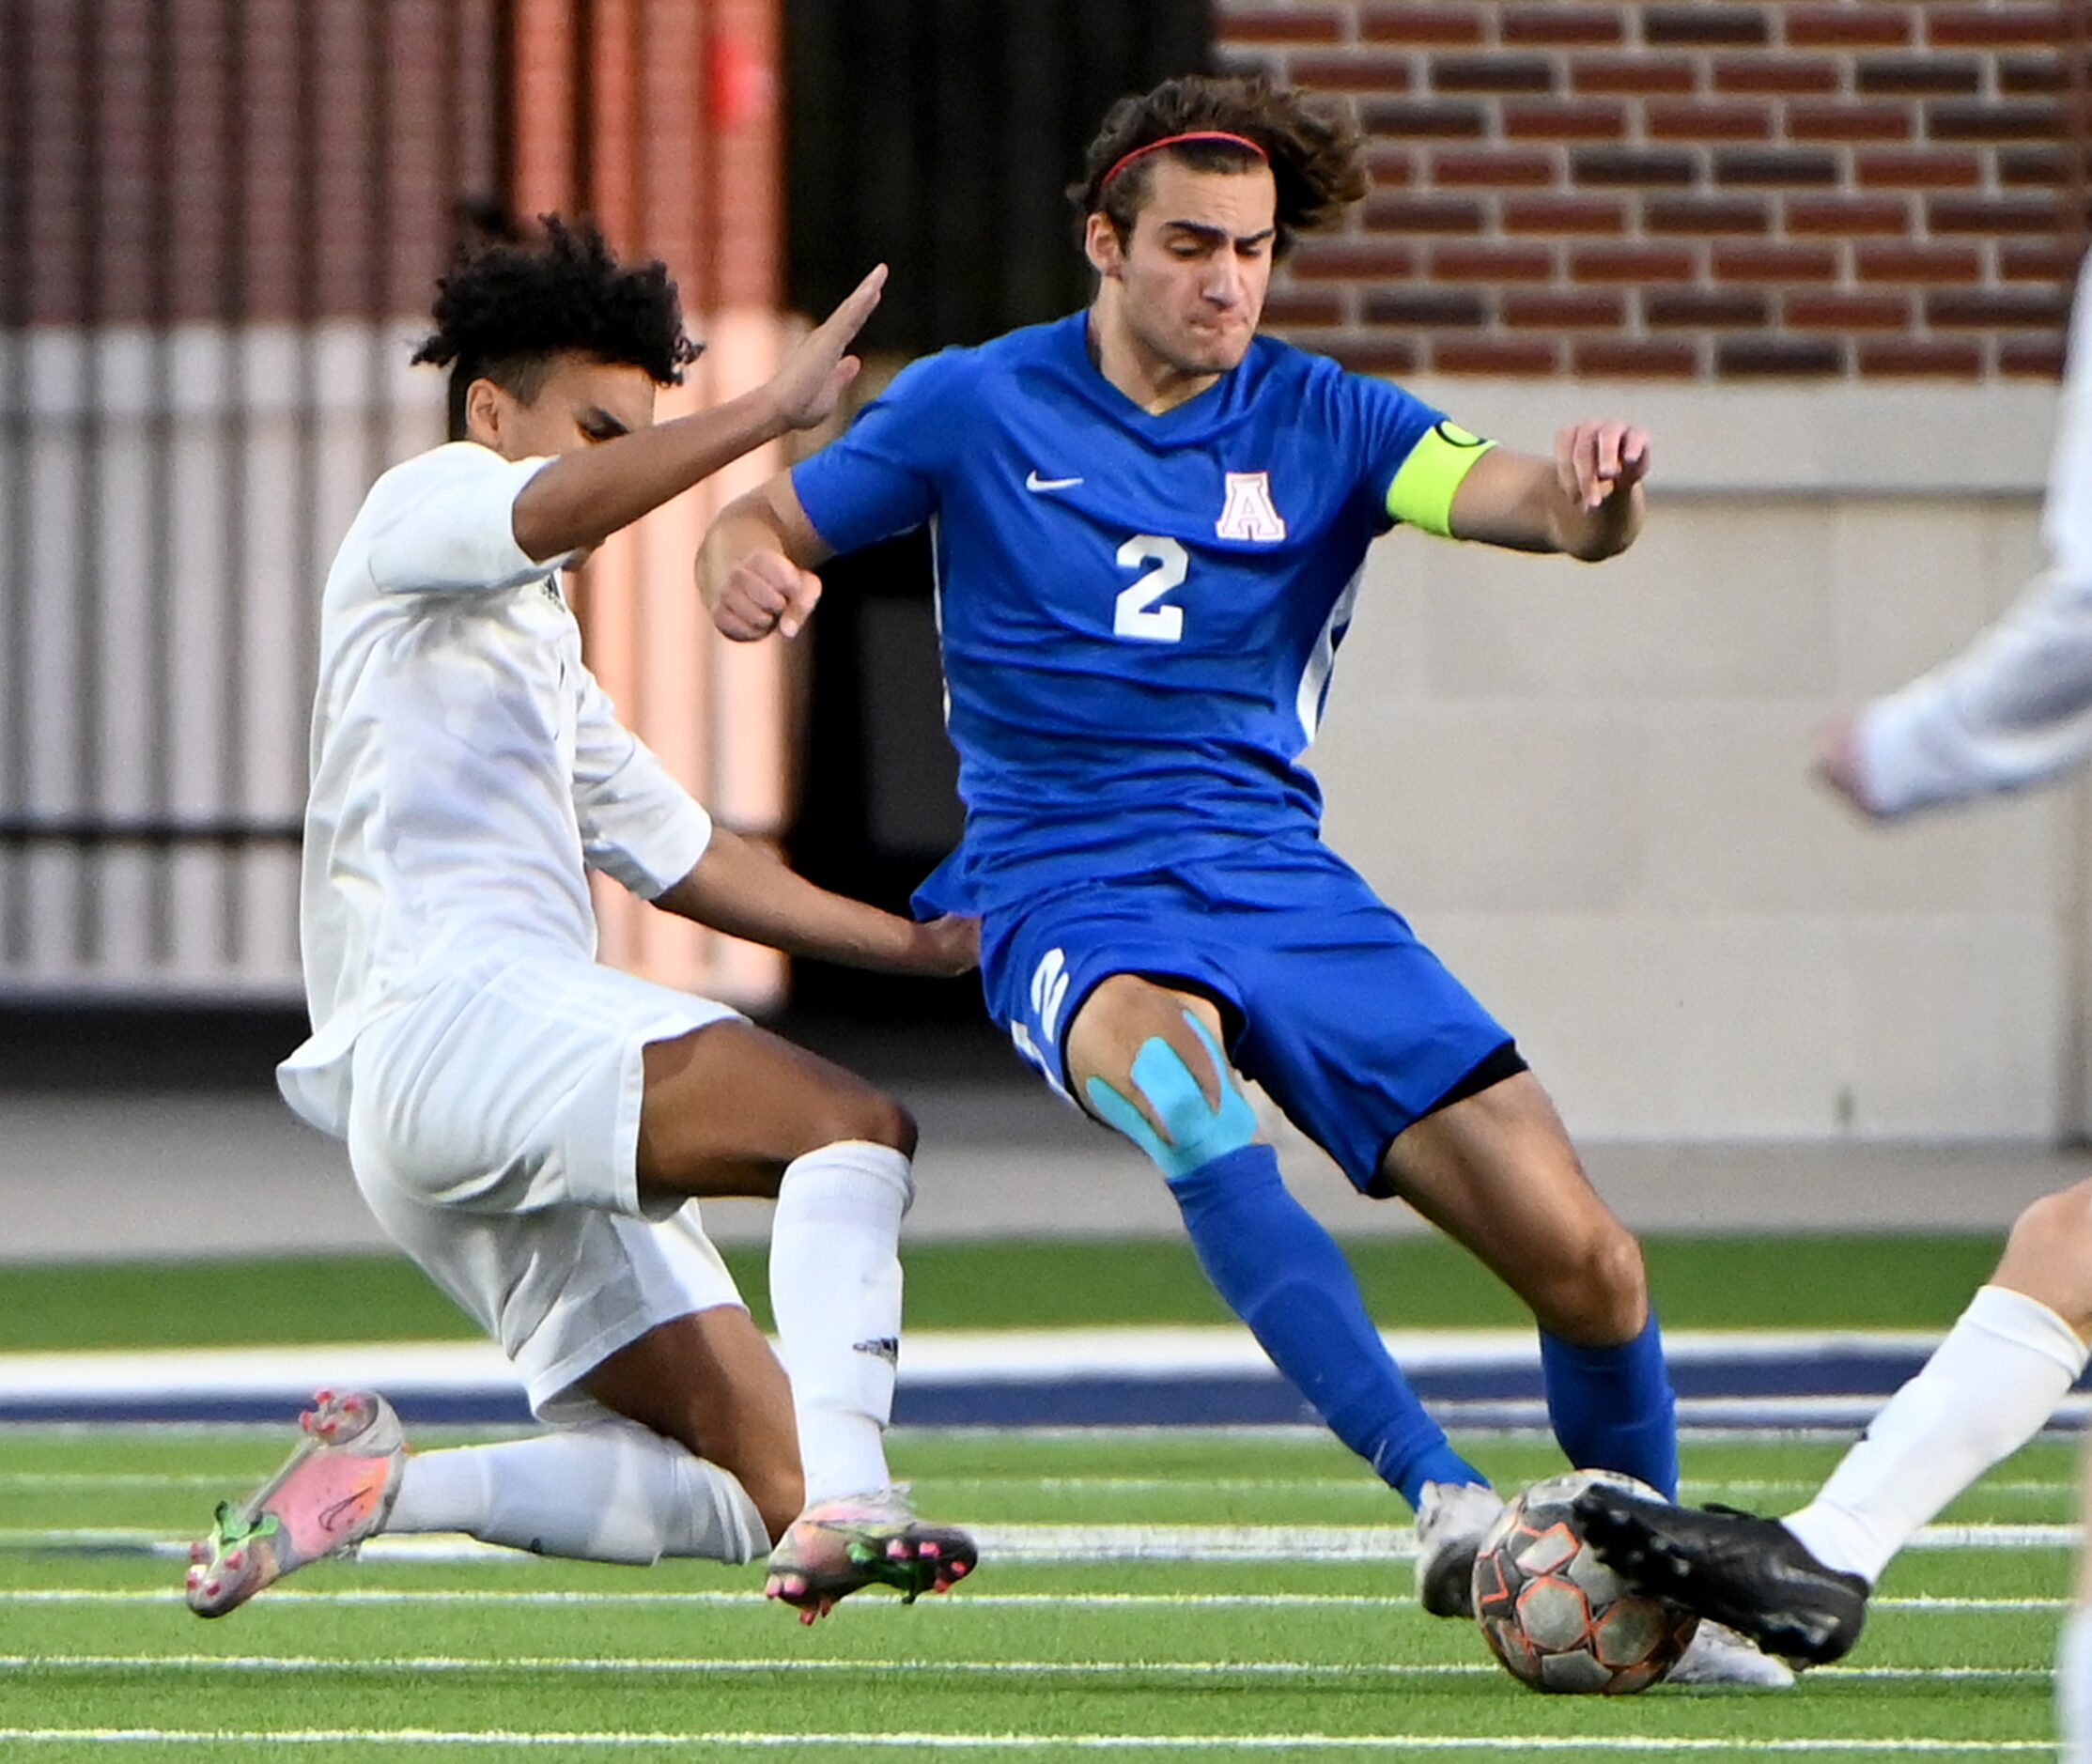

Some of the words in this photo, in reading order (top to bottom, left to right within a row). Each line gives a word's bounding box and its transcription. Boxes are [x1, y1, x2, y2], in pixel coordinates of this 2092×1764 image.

[1216, 472, 1286, 542] A
[1113, 533, 1189, 642] 2
[1031, 947, 1069, 1045] 2
